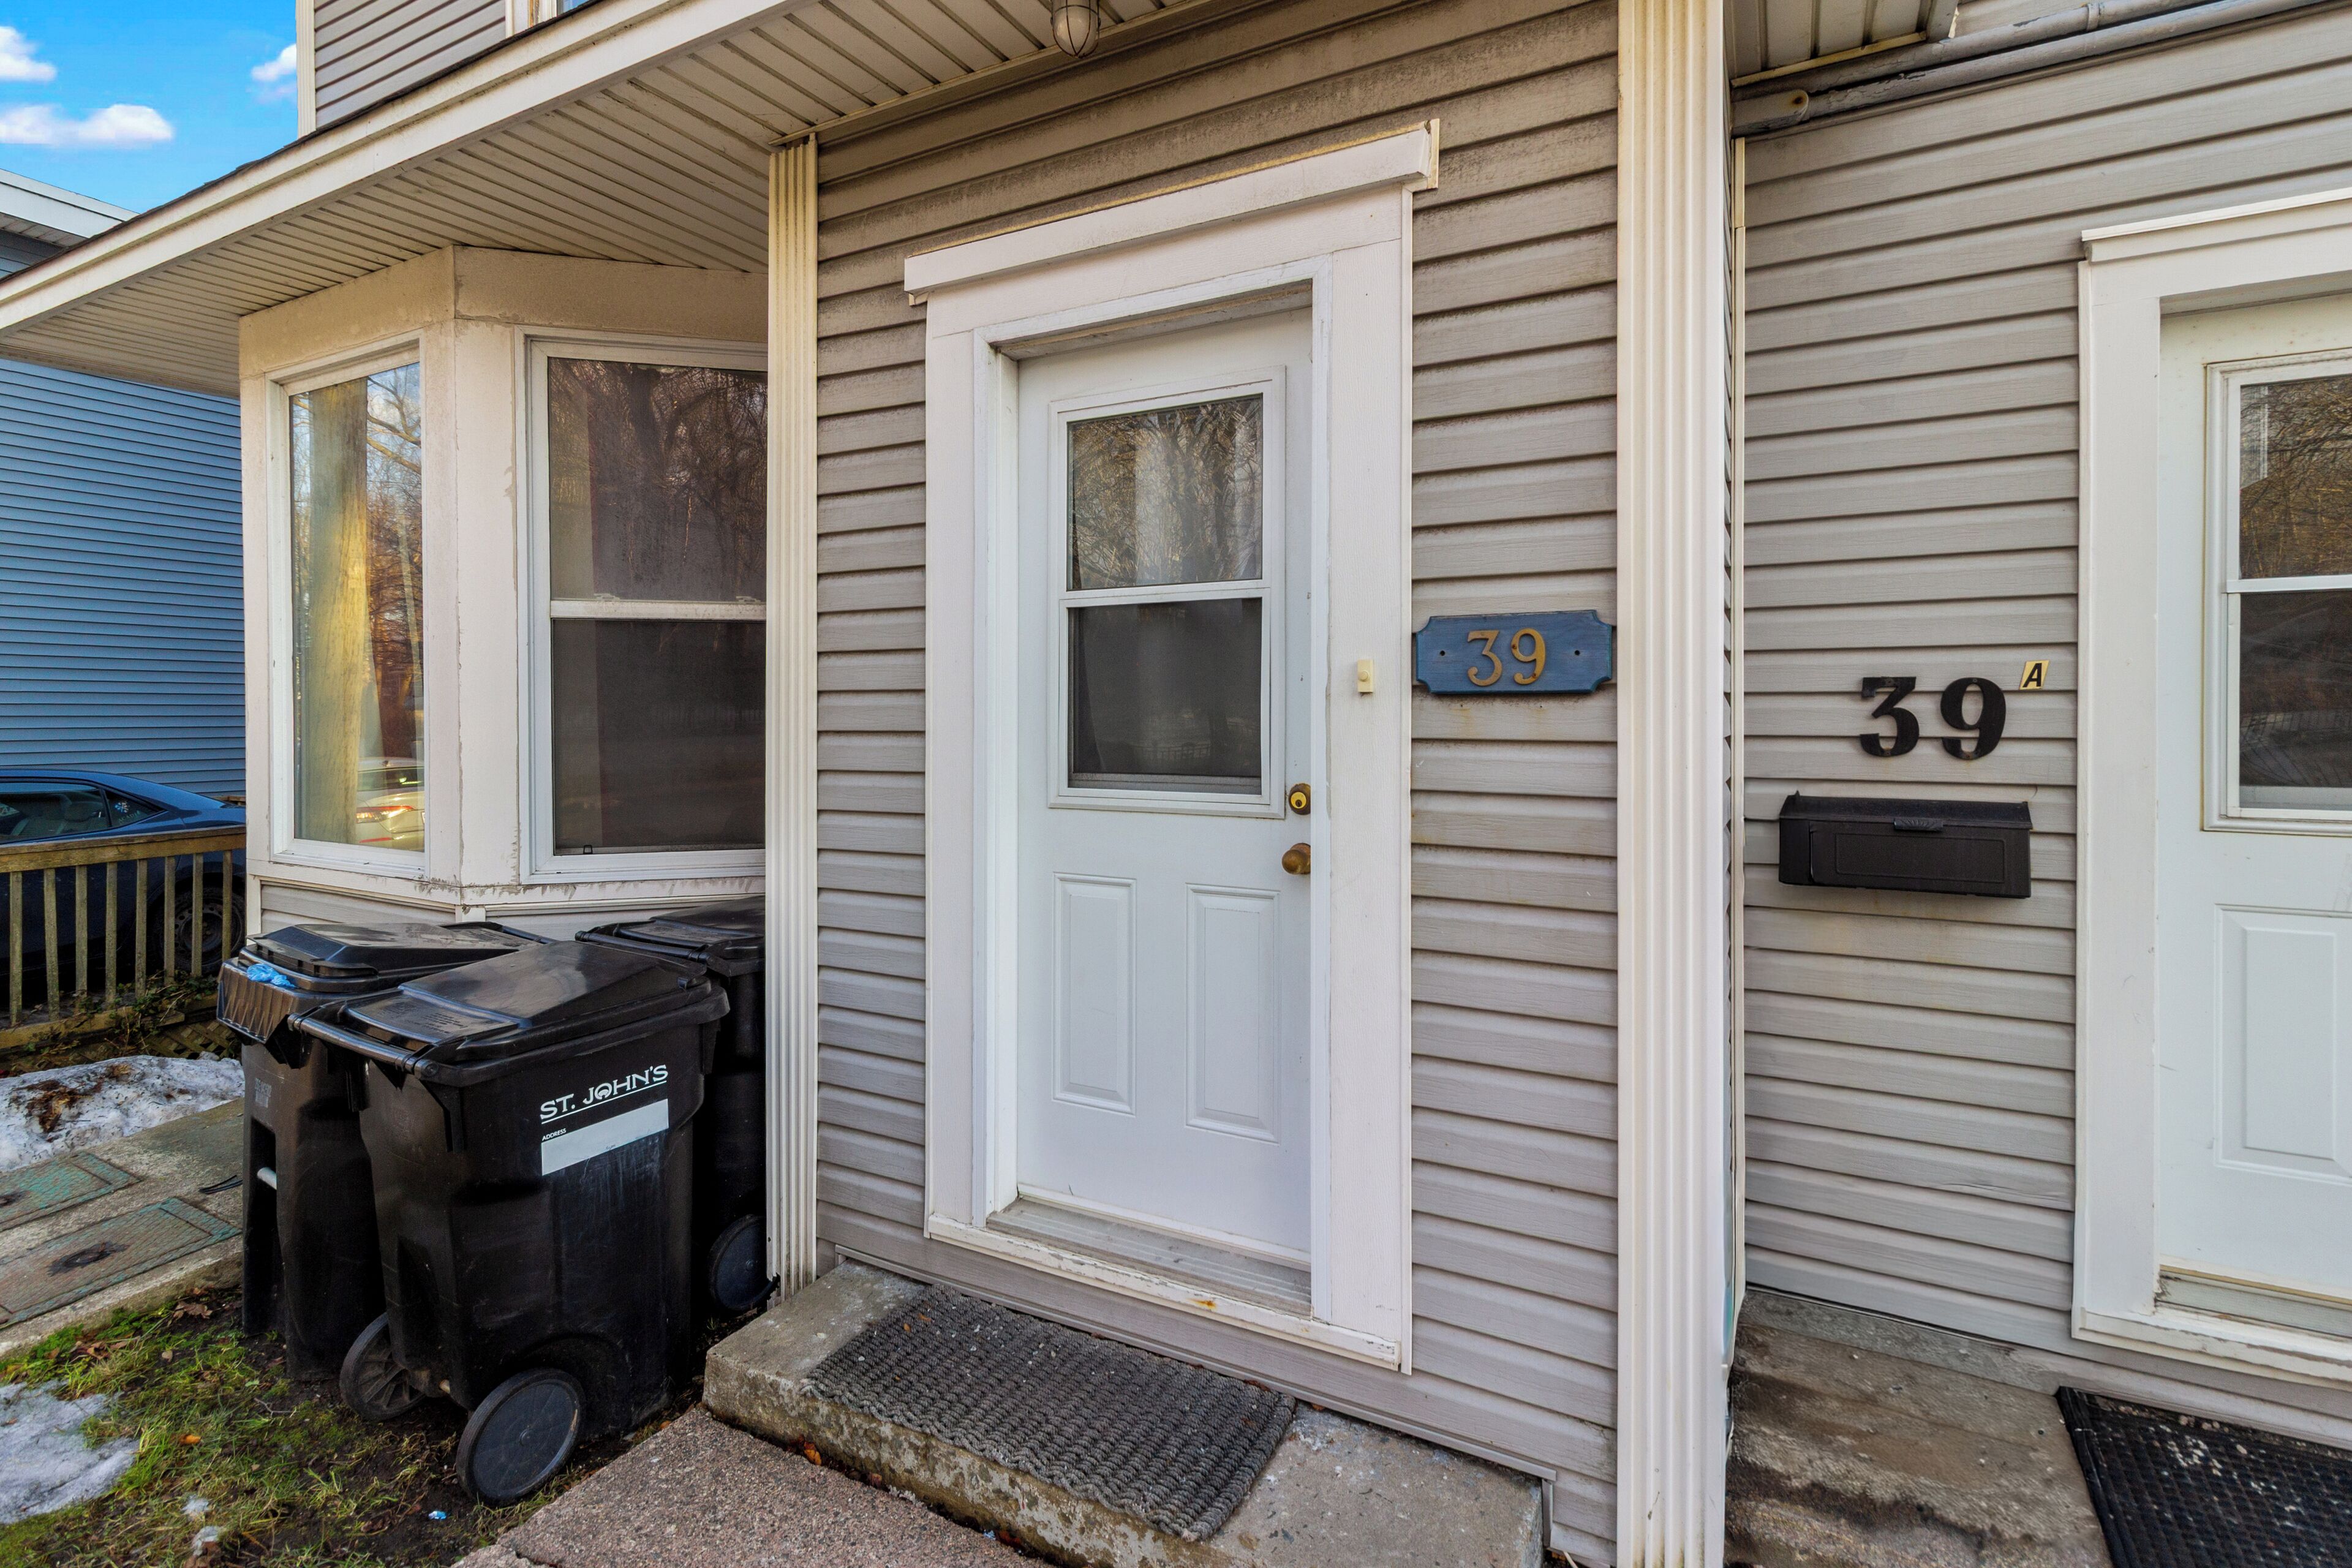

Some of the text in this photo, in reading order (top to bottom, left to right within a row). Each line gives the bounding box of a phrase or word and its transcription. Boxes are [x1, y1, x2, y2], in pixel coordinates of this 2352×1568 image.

[1467, 628, 1546, 687] 39
[1860, 663, 2043, 760] 39 A
[540, 1064, 668, 1120] ST. JOHN'S
[542, 1128, 567, 1141] ADDRESS
